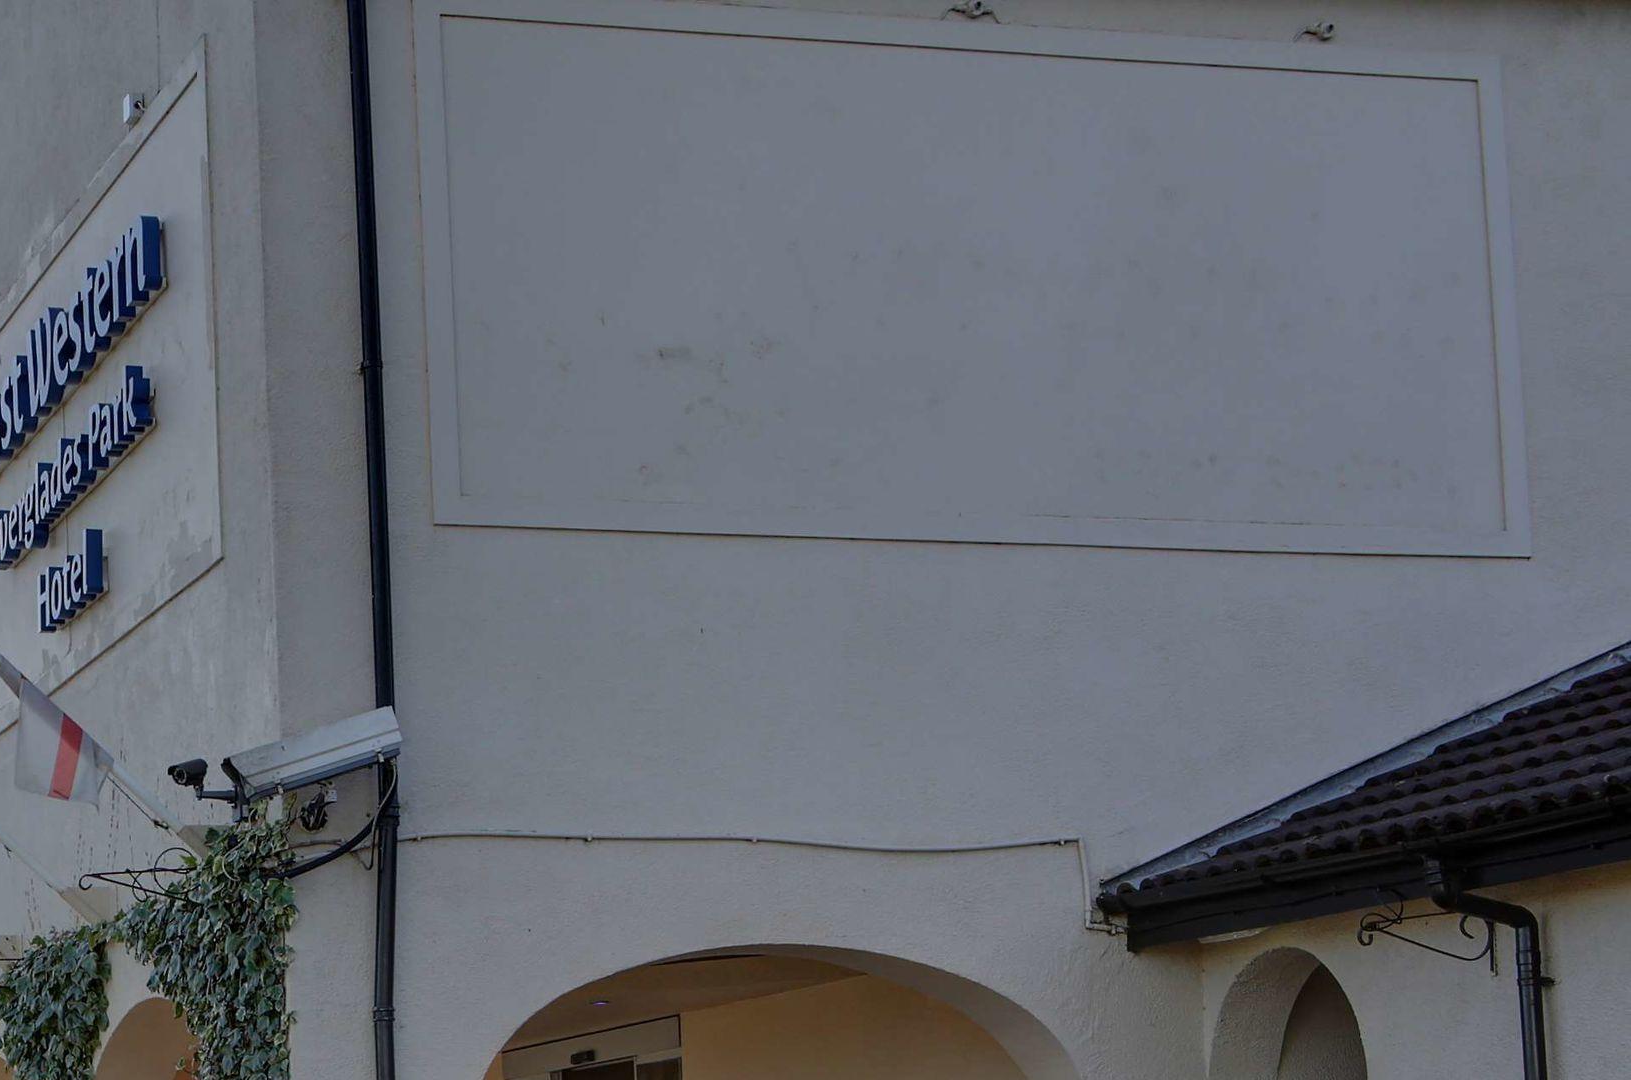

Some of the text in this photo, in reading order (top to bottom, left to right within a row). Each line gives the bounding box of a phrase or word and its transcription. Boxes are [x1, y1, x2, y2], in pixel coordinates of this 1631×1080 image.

[26, 216, 150, 418] Western
[88, 366, 140, 470] Park
[36, 529, 93, 634] Hotel
